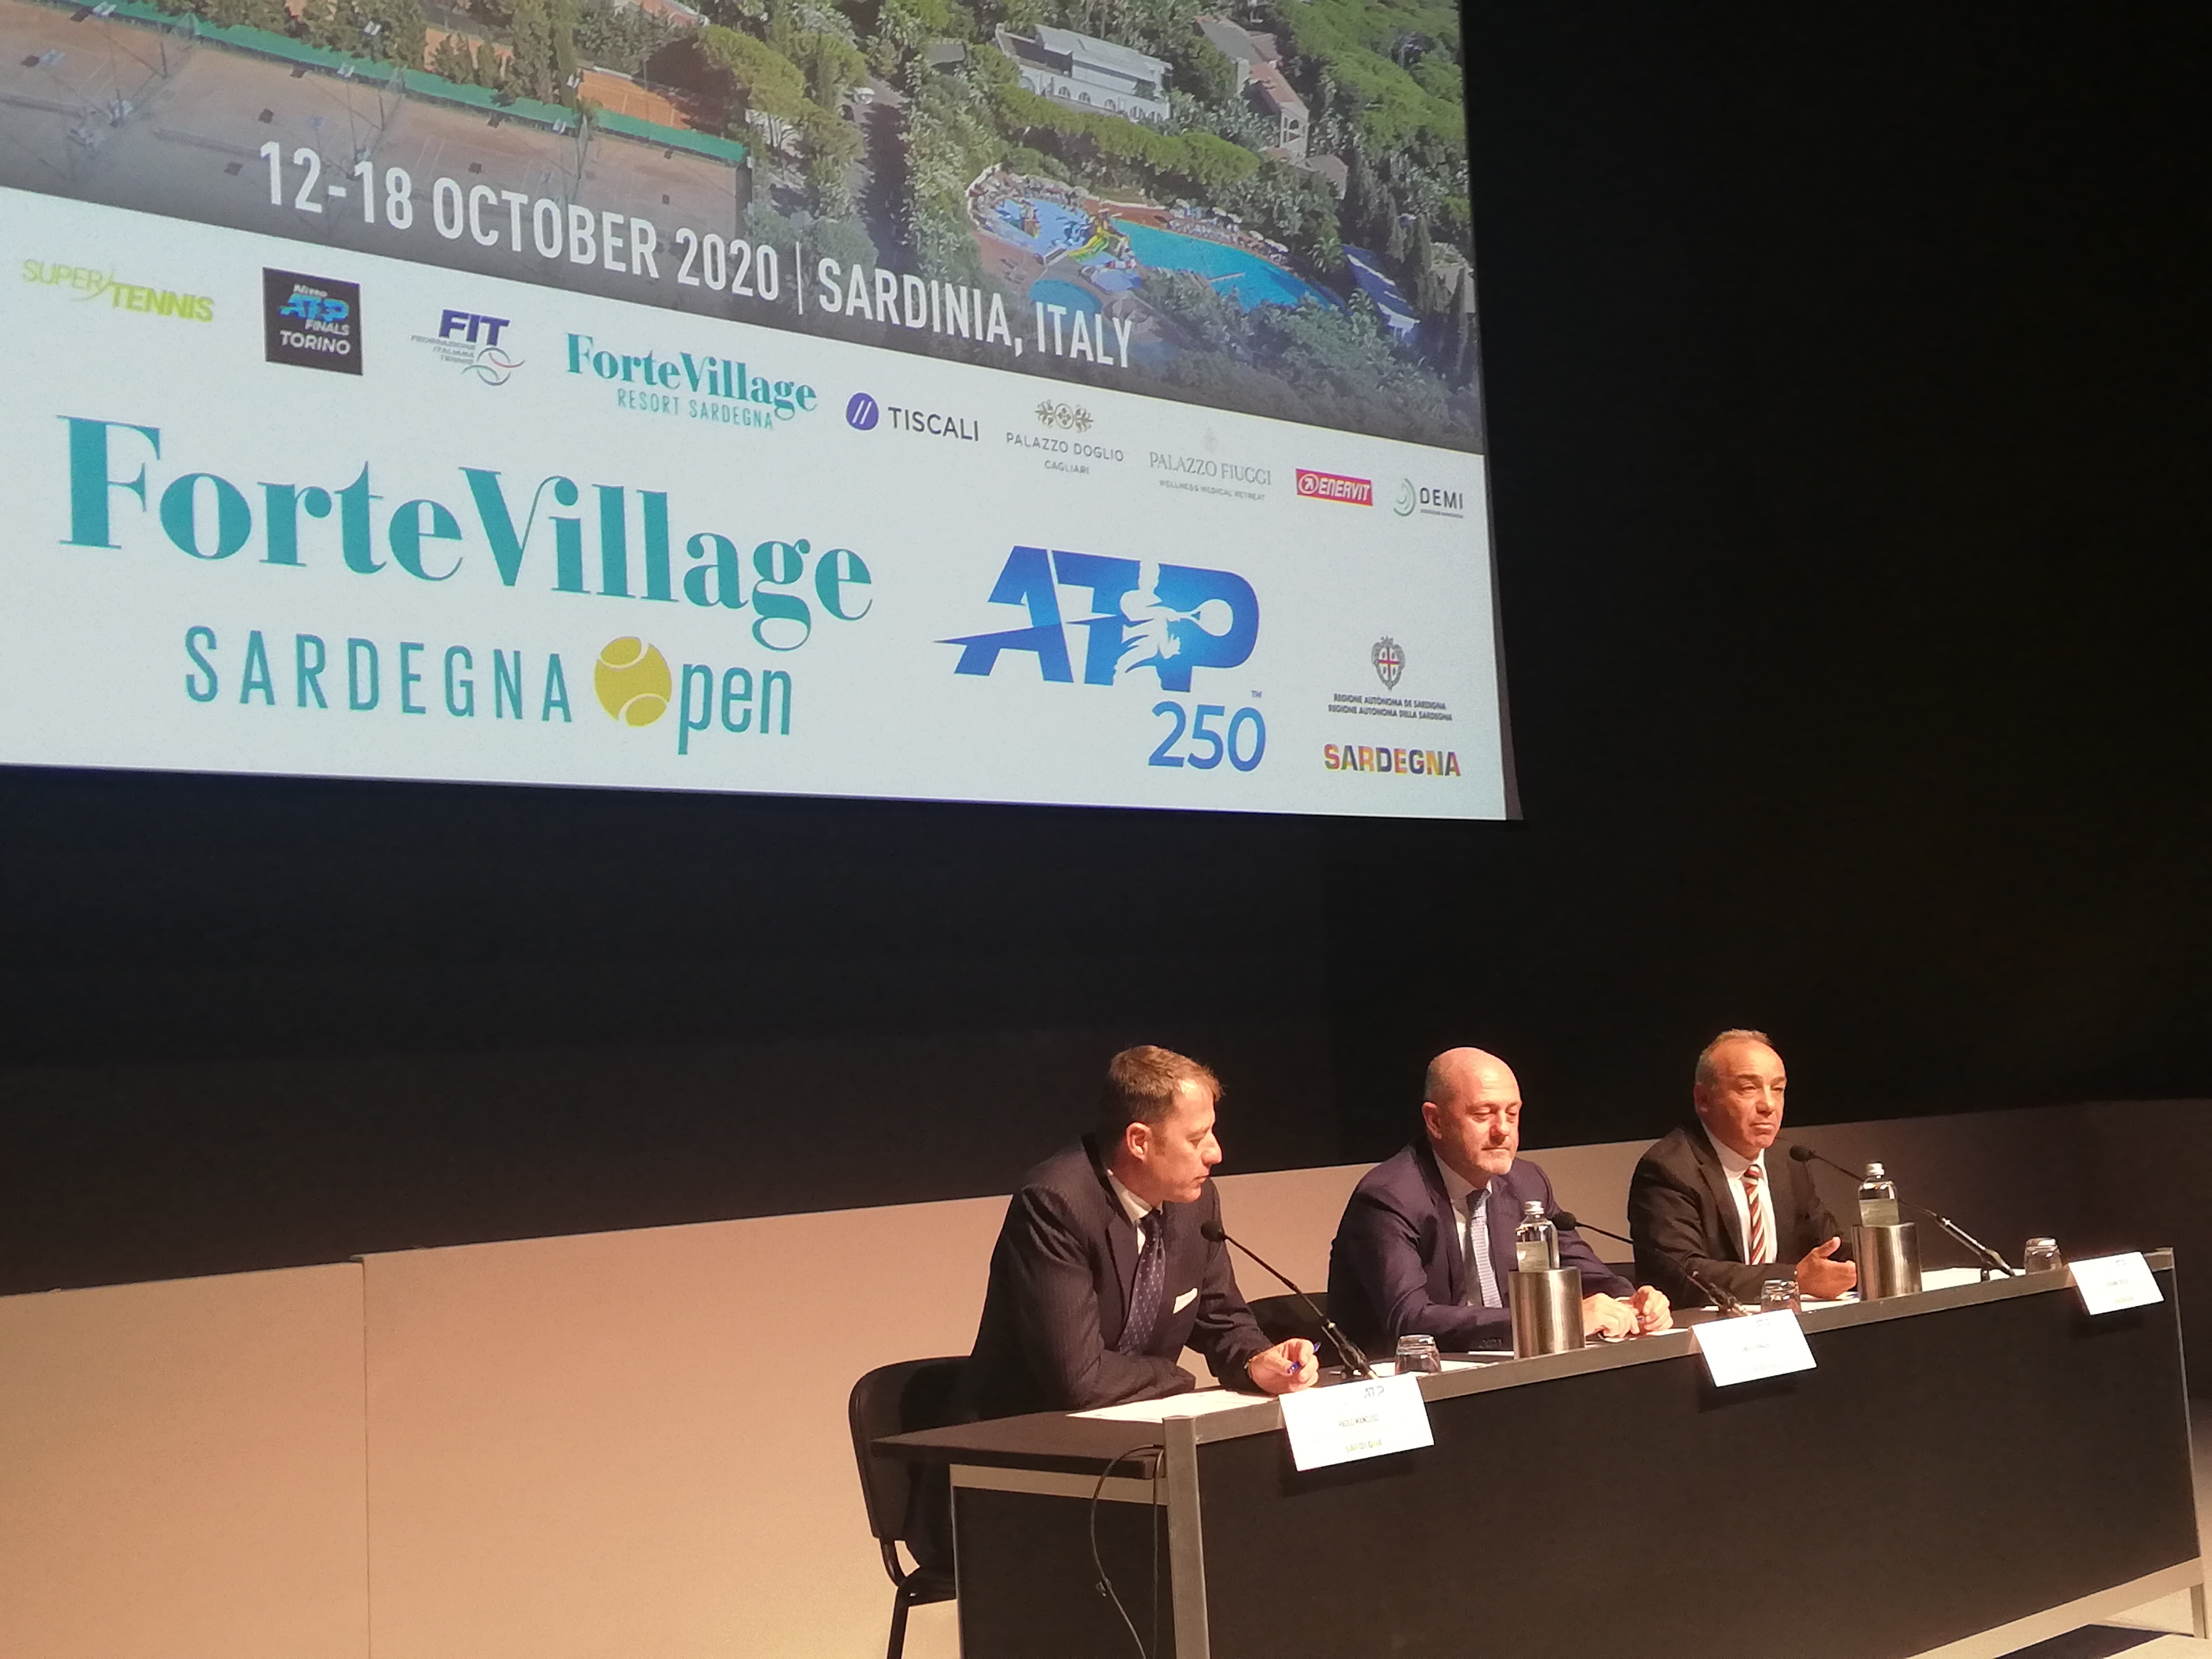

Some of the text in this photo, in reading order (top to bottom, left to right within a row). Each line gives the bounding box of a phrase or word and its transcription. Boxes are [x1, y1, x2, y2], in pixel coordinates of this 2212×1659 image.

[260, 141, 1132, 367] 12-18 OCTOBER 2020 SARDINIA, ITALY
[279, 293, 349, 322] ATP
[279, 329, 350, 355] TORINO
[305, 319, 350, 336] FINALS
[439, 309, 510, 346] FIT
[617, 388, 774, 429] RESORT SARDEGNA
[888, 407, 979, 441] TISCALI
[1006, 433, 1124, 462] PALAZZO DOGLIO
[1149, 451, 1217, 477] PALAZZO
[1044, 460, 1090, 475] CAGLIARI
[933, 545, 1259, 692] ATP
[185, 625, 572, 723] SARDEGNA
[1148, 701, 1266, 772] 250
[1324, 744, 1461, 777] SARDEGNA
